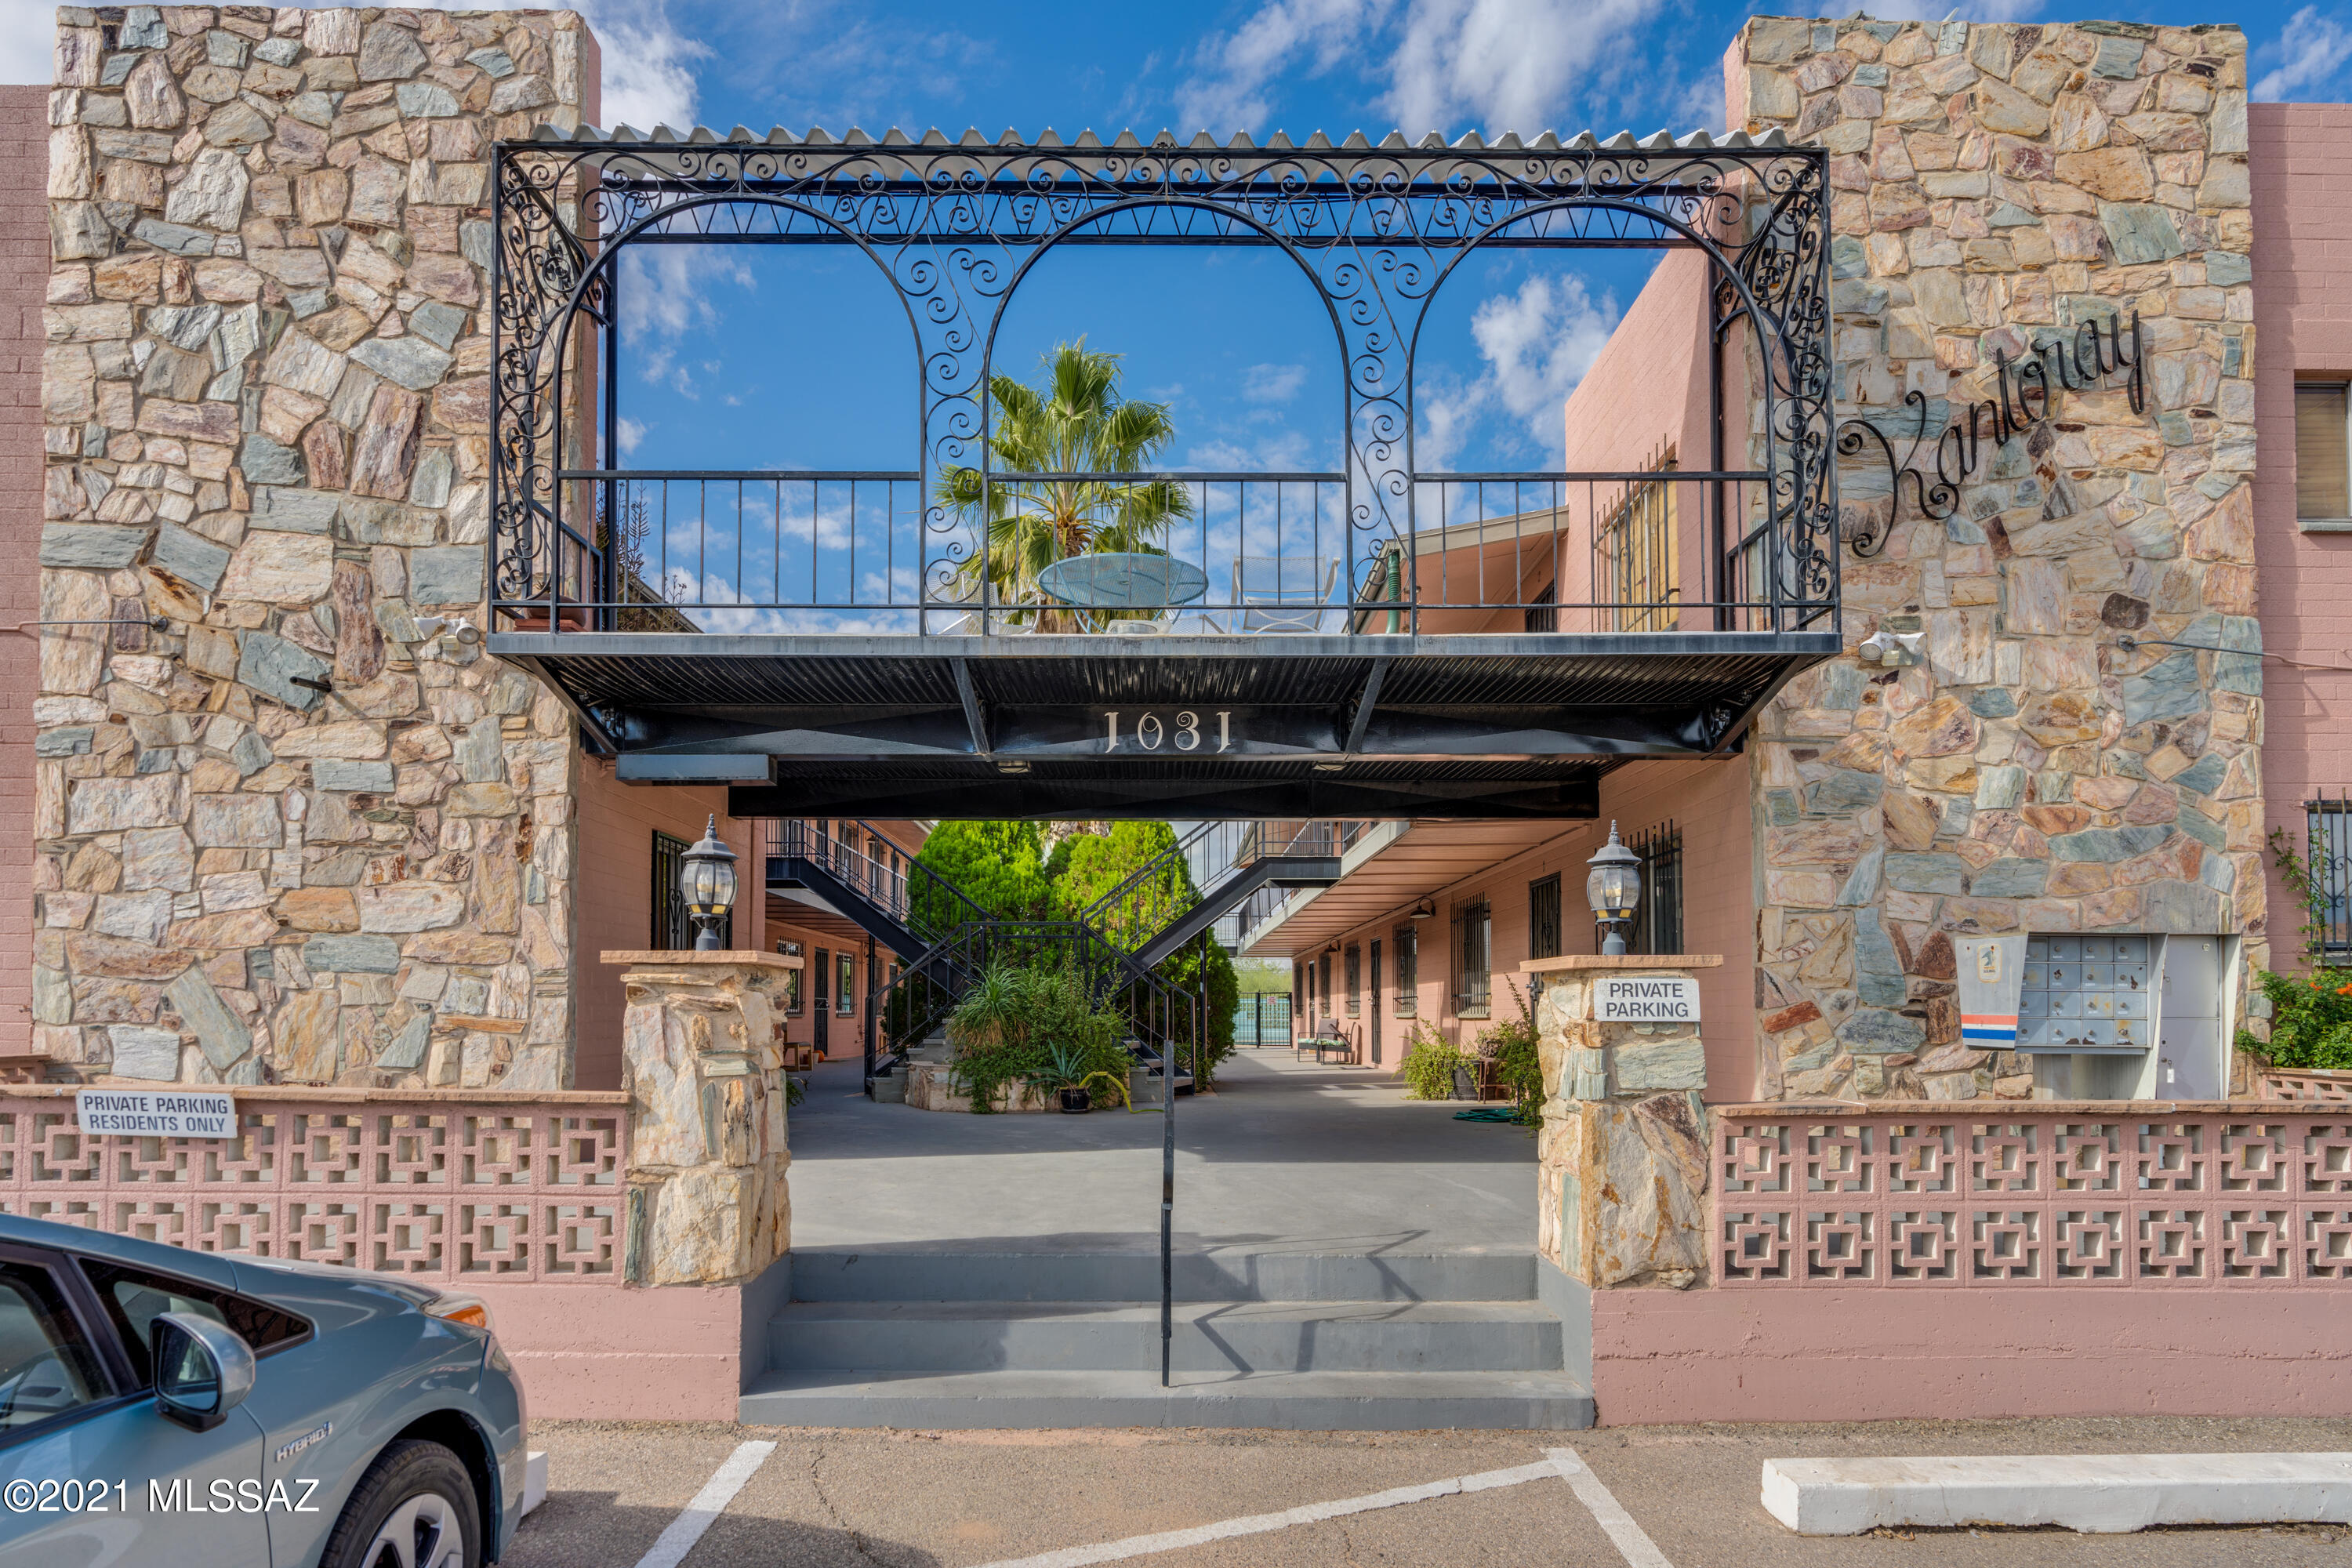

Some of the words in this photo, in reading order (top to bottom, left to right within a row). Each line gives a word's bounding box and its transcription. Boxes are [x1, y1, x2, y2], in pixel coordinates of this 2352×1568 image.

[1104, 710, 1232, 753] 1031
[1610, 982, 1683, 998] PRIVATE
[1606, 1002, 1689, 1017] PARKING
[84, 1095, 149, 1112] PRIVATE
[156, 1098, 228, 1114] PARKING
[89, 1114, 178, 1131] RESIDENTS
[186, 1116, 225, 1132] ONLY
[274, 1428, 326, 1463] HYBRID
